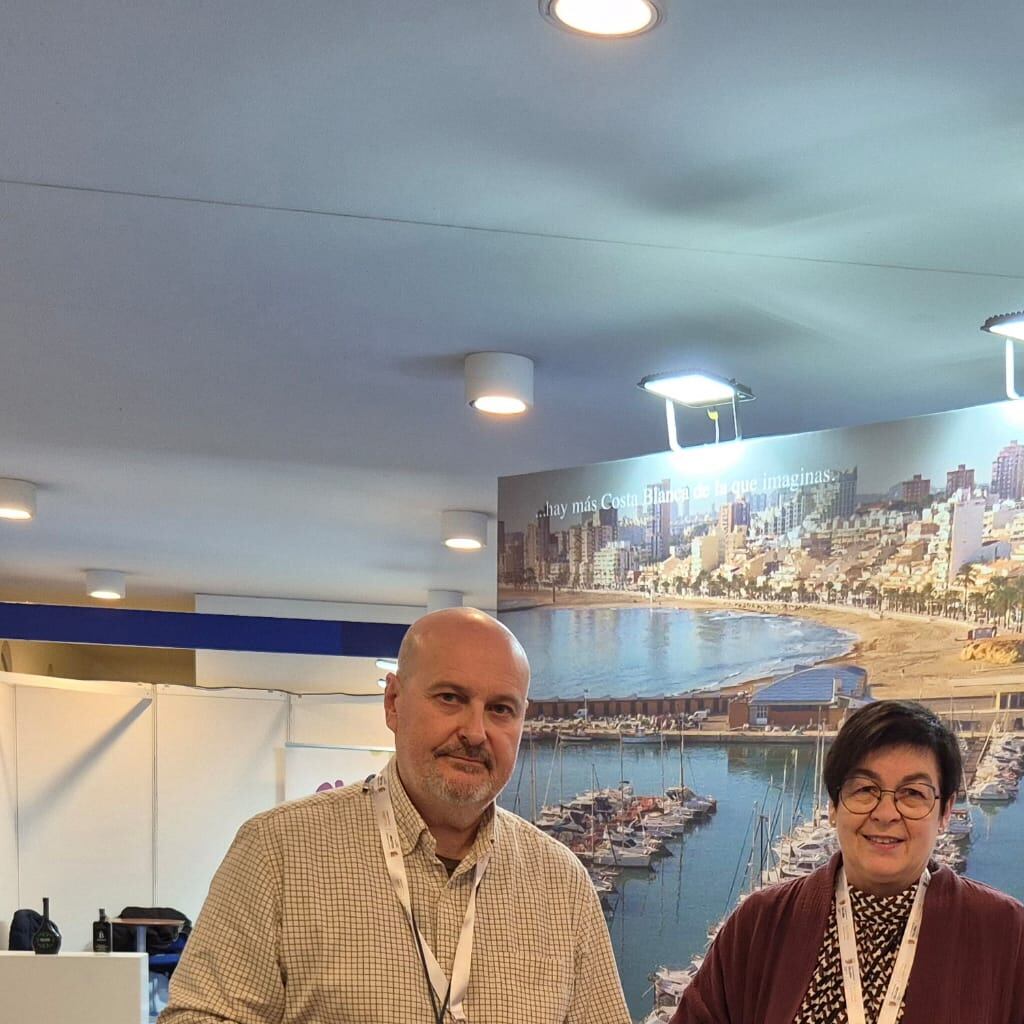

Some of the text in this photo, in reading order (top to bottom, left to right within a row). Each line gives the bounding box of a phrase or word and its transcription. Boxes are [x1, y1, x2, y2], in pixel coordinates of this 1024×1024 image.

[571, 497, 597, 514] más
[600, 491, 638, 510] Costa
[642, 485, 690, 506] Blanca
[692, 480, 709, 499] de
[714, 478, 727, 496] la
[731, 479, 758, 500] que
[763, 467, 836, 493] imaginas.
